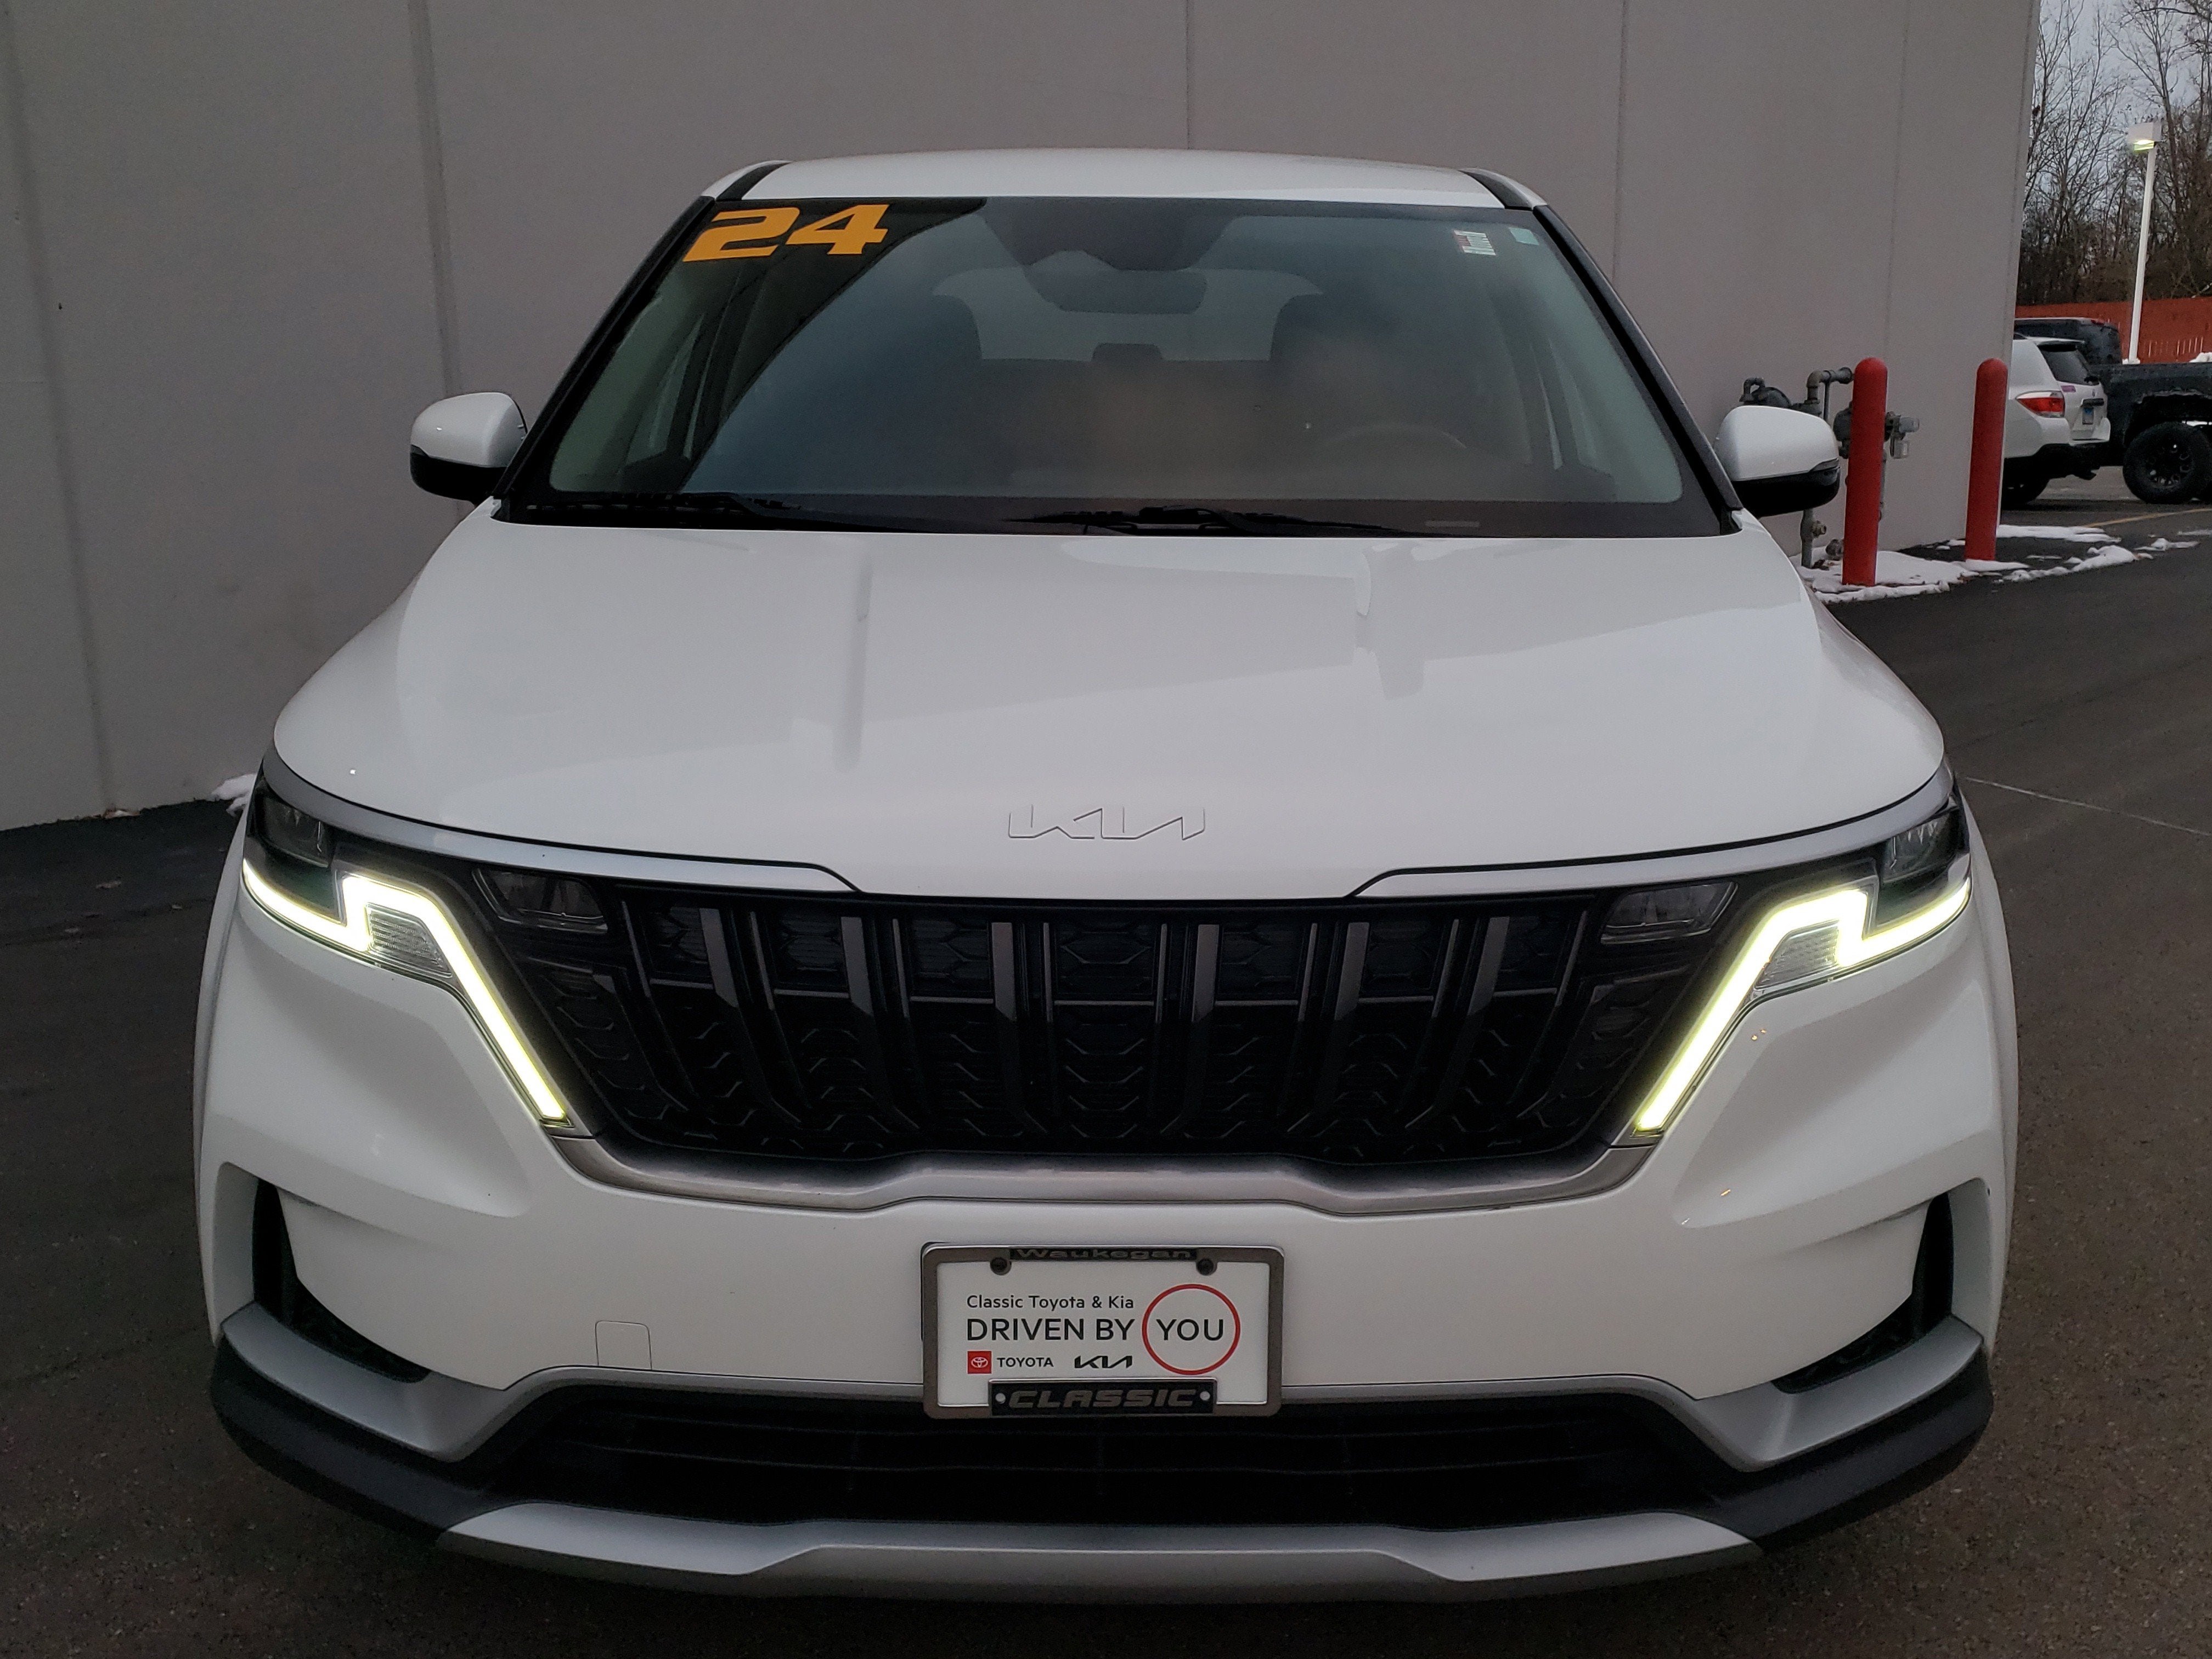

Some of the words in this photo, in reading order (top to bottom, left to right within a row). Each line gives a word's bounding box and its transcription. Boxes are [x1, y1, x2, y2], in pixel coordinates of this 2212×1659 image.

[682, 204, 889, 262] 24
[1015, 1248, 1191, 1260] Waukegan
[967, 1295, 1023, 1309] Classic
[1029, 1295, 1085, 1311] Toyota
[1092, 1295, 1103, 1309] &
[1108, 1295, 1134, 1309] Kia
[967, 1318, 1084, 1341] DRIVEN
[1096, 1318, 1135, 1340] BY
[1156, 1319, 1224, 1341] YOU
[997, 1357, 1054, 1368] TOYOTA
[1074, 1355, 1132, 1369] KIA
[1008, 1390, 1197, 1408] CLASSIC
